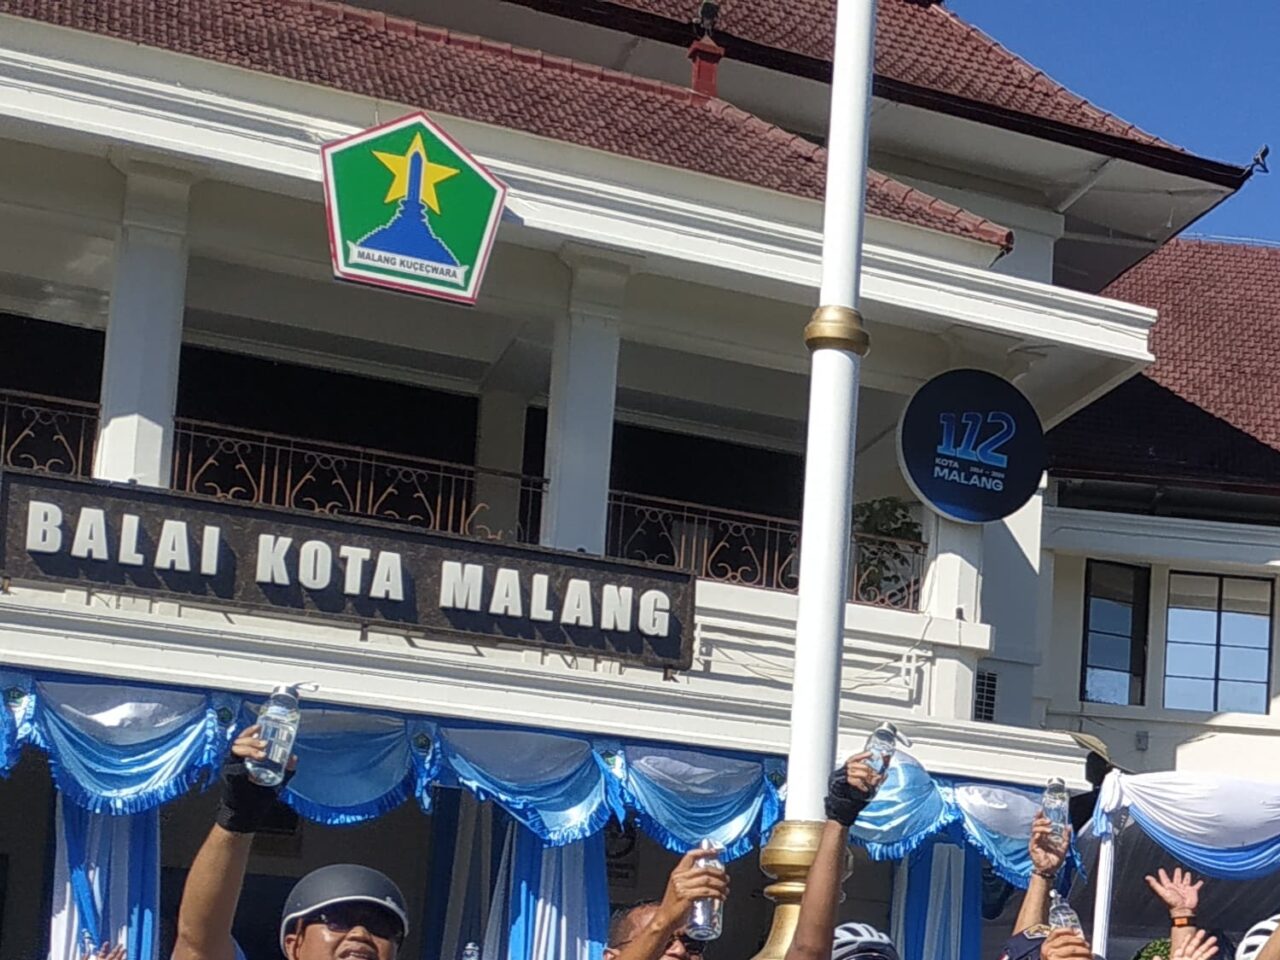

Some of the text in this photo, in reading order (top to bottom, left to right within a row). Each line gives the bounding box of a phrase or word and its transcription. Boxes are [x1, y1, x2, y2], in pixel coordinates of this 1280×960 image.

[356, 250, 397, 267] MALANG
[936, 411, 1016, 468] 112
[935, 457, 959, 468] KOTA
[933, 466, 1004, 491] MALANG
[26, 499, 671, 638] BALAI KOTA MALANG
